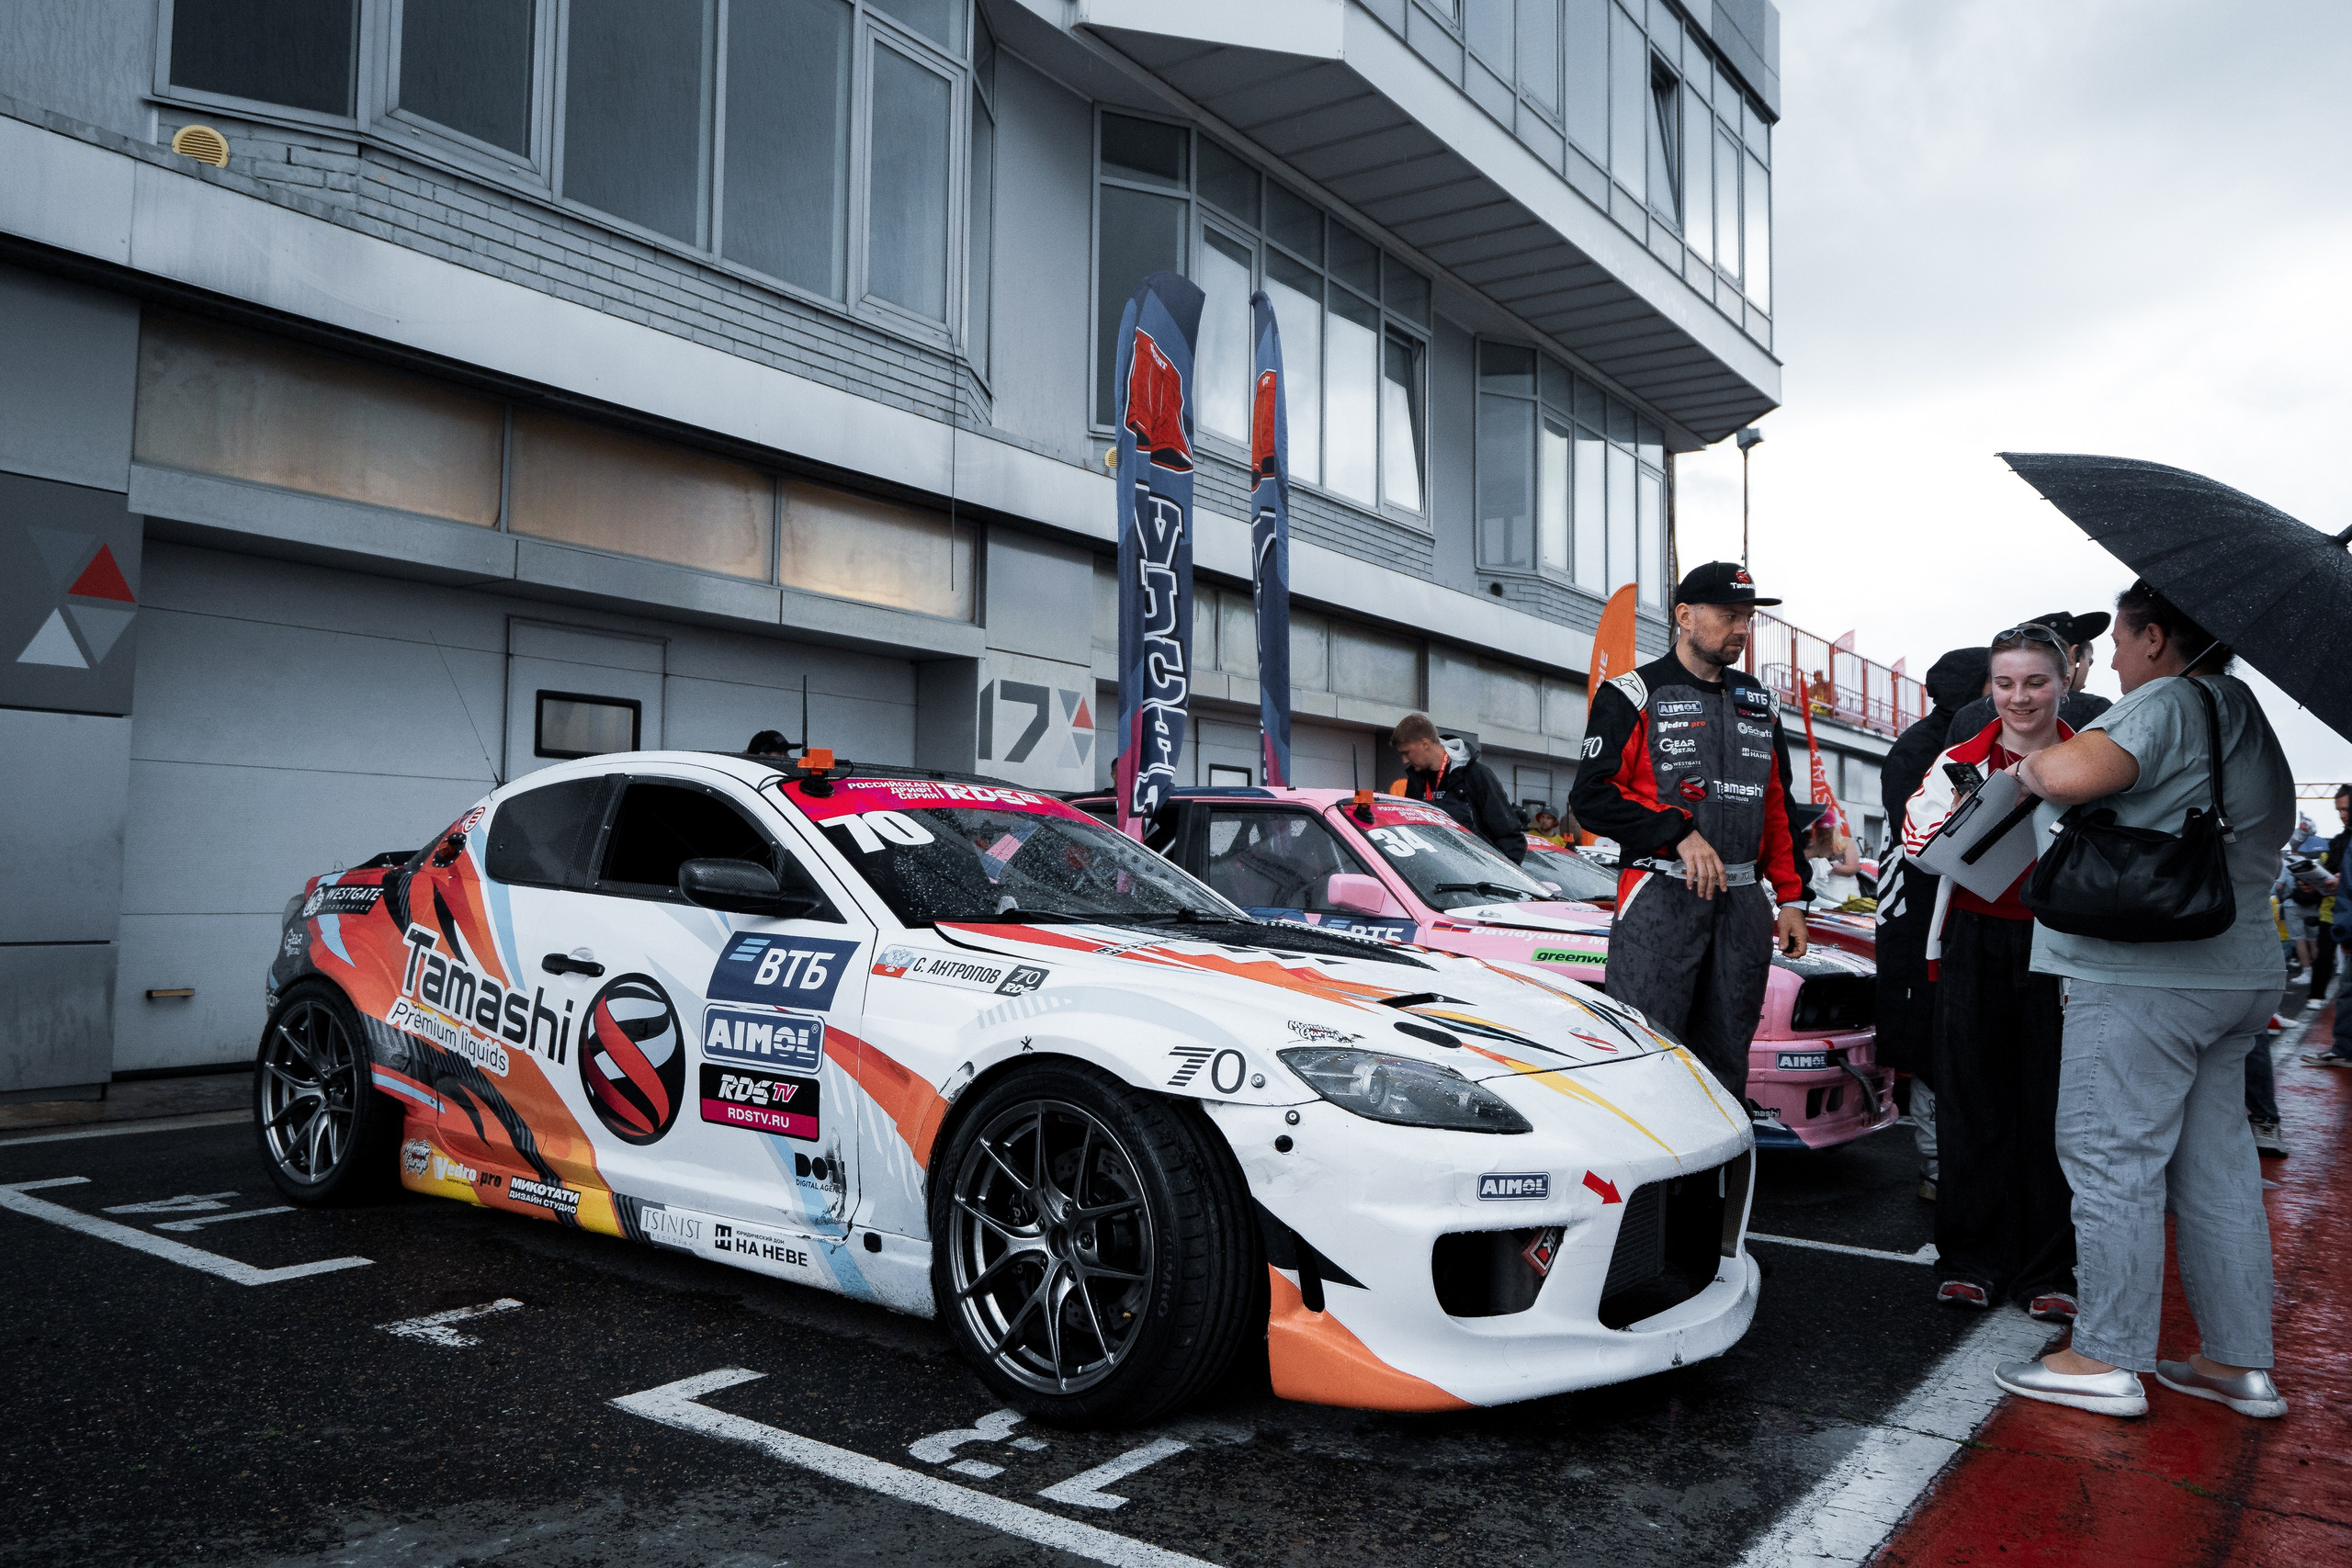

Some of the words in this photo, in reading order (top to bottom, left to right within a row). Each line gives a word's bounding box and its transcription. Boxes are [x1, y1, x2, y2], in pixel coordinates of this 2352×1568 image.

[1747, 691, 1768, 705] ВТБ
[978, 678, 1050, 764] 17
[1580, 736, 1603, 761] 70
[1659, 738, 1695, 752] GEAR
[847, 781, 931, 790] РОССИЙСКАЯ
[890, 787, 933, 795] ДРИФТ
[898, 792, 940, 800] СЕРИЯ
[1713, 780, 1764, 797] Tamashi
[818, 810, 935, 854] 70
[1367, 827, 1439, 857] 34
[325, 887, 385, 901] WESTGATE
[1469, 926, 1582, 943] Davidyants
[753, 947, 836, 990] ВТБ
[912, 957, 924, 973] С.
[926, 959, 1002, 985] АНТРОПОВ
[1012, 967, 1041, 986] 70
[404, 928, 573, 1066] Tamashi
[391, 1000, 458, 1048] Premium
[460, 1030, 507, 1072] liquids
[1167, 1044, 1248, 1095] 70
[728, 1107, 790, 1128] RDSTV.RU
[1752, 1108, 1780, 1118] mashi
[511, 1177, 582, 1204] МИКОТАТИ
[796, 1179, 819, 1190] DIGITAL
[508, 1190, 542, 1205] ДИЗАЙН
[543, 1199, 578, 1214] СТУДИО
[644, 1209, 703, 1240] TSINIST
[736, 1230, 774, 1242] ЮРИДИЧЕСКИЙ
[774, 1237, 785, 1246] ДОМ
[736, 1238, 760, 1257] НА
[763, 1243, 808, 1268] НЕВЕ
[1158, 1227, 1173, 1317] KUMHO
